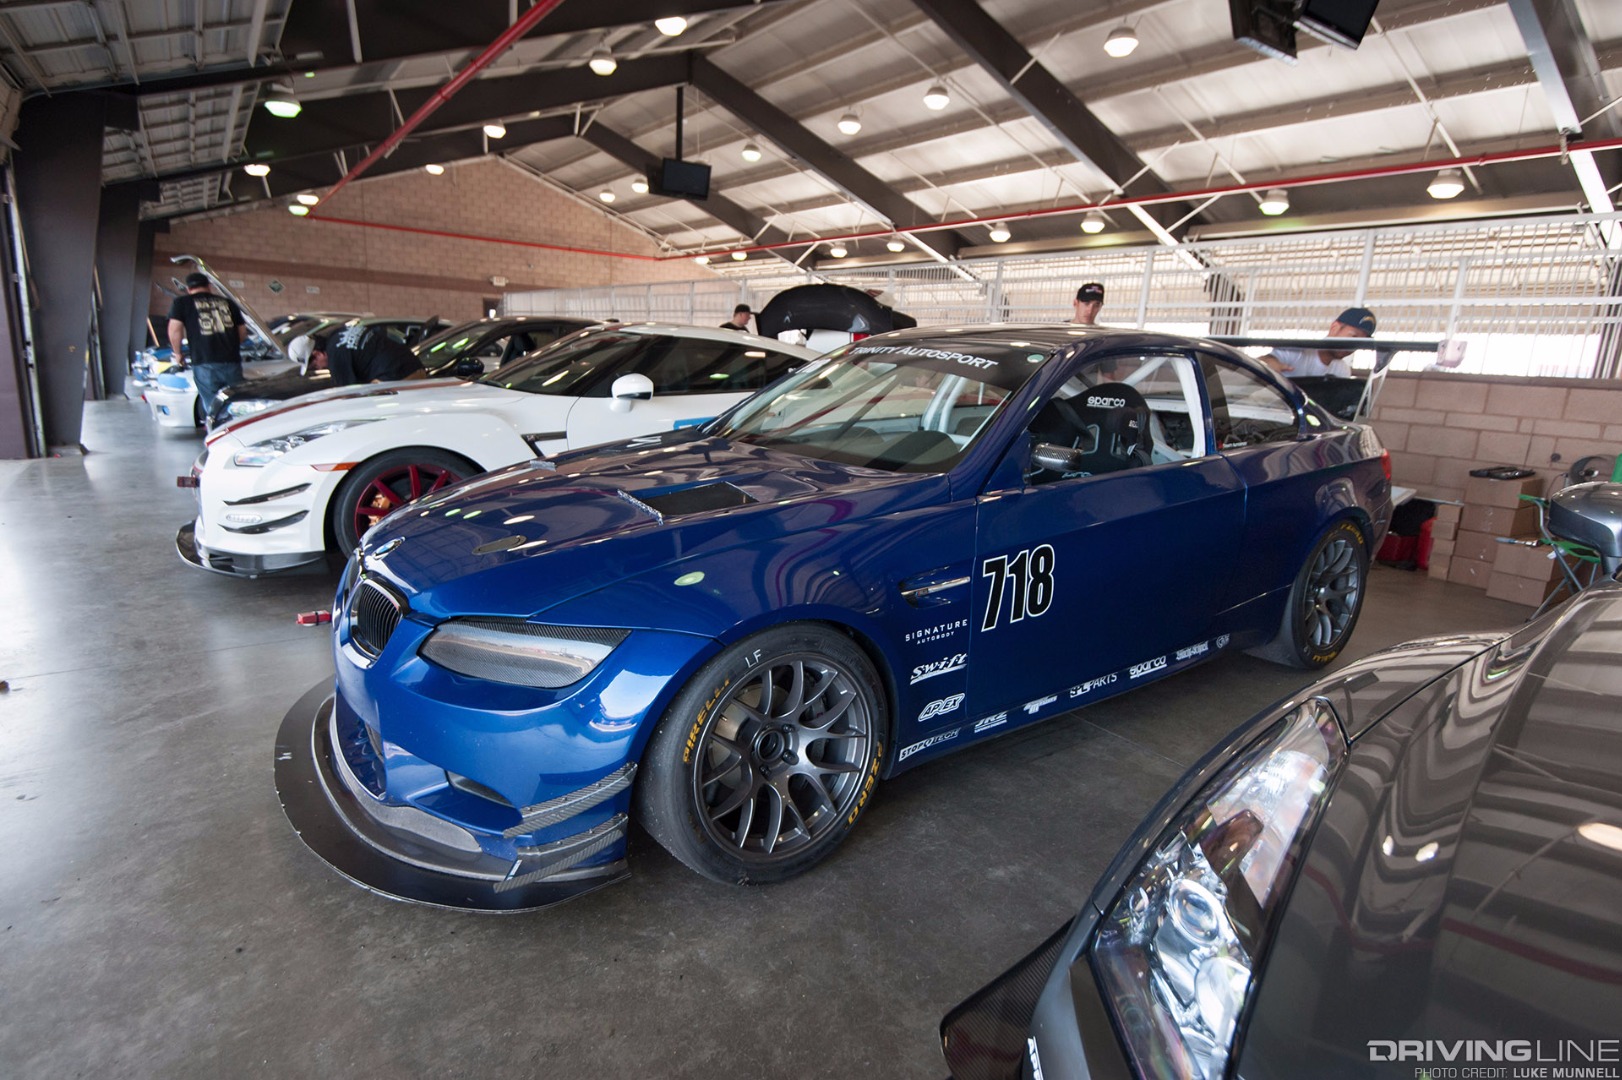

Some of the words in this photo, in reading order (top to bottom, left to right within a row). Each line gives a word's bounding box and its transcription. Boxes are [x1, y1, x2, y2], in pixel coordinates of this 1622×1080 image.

[897, 346, 999, 370] AUTOSPORT
[1087, 395, 1126, 408] sparco
[981, 543, 1056, 633] 718
[905, 618, 968, 642] SIGNATURE
[916, 631, 955, 645] AUTOBODY
[744, 648, 762, 669] LF
[1129, 655, 1167, 677] sparco
